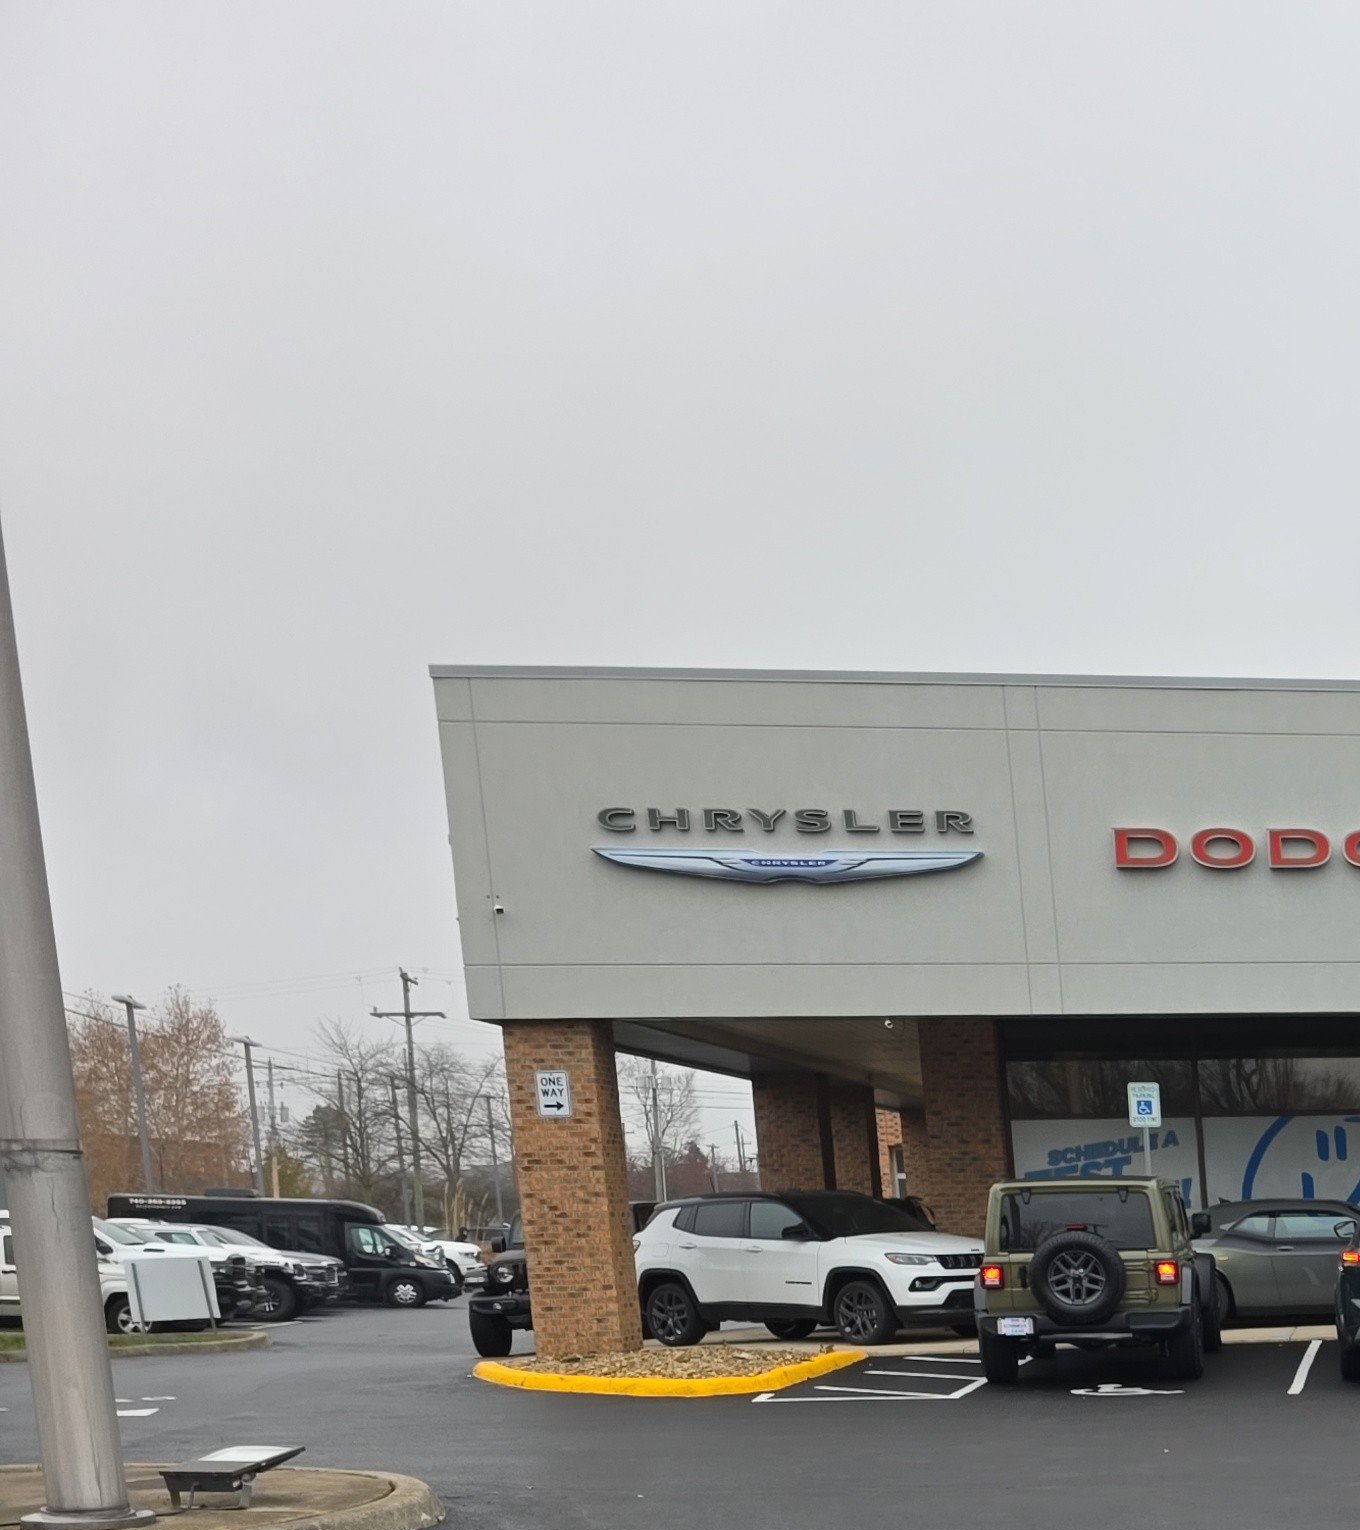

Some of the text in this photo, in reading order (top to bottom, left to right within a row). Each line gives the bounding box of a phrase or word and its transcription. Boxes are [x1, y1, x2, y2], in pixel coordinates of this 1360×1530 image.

[598, 807, 974, 834] CHRYSLER
[540, 1077, 564, 1087] ONE
[541, 1088, 565, 1097] WAY
[1047, 1130, 1180, 1166] SCHEDULE A
[1024, 1155, 1132, 1180] ST
